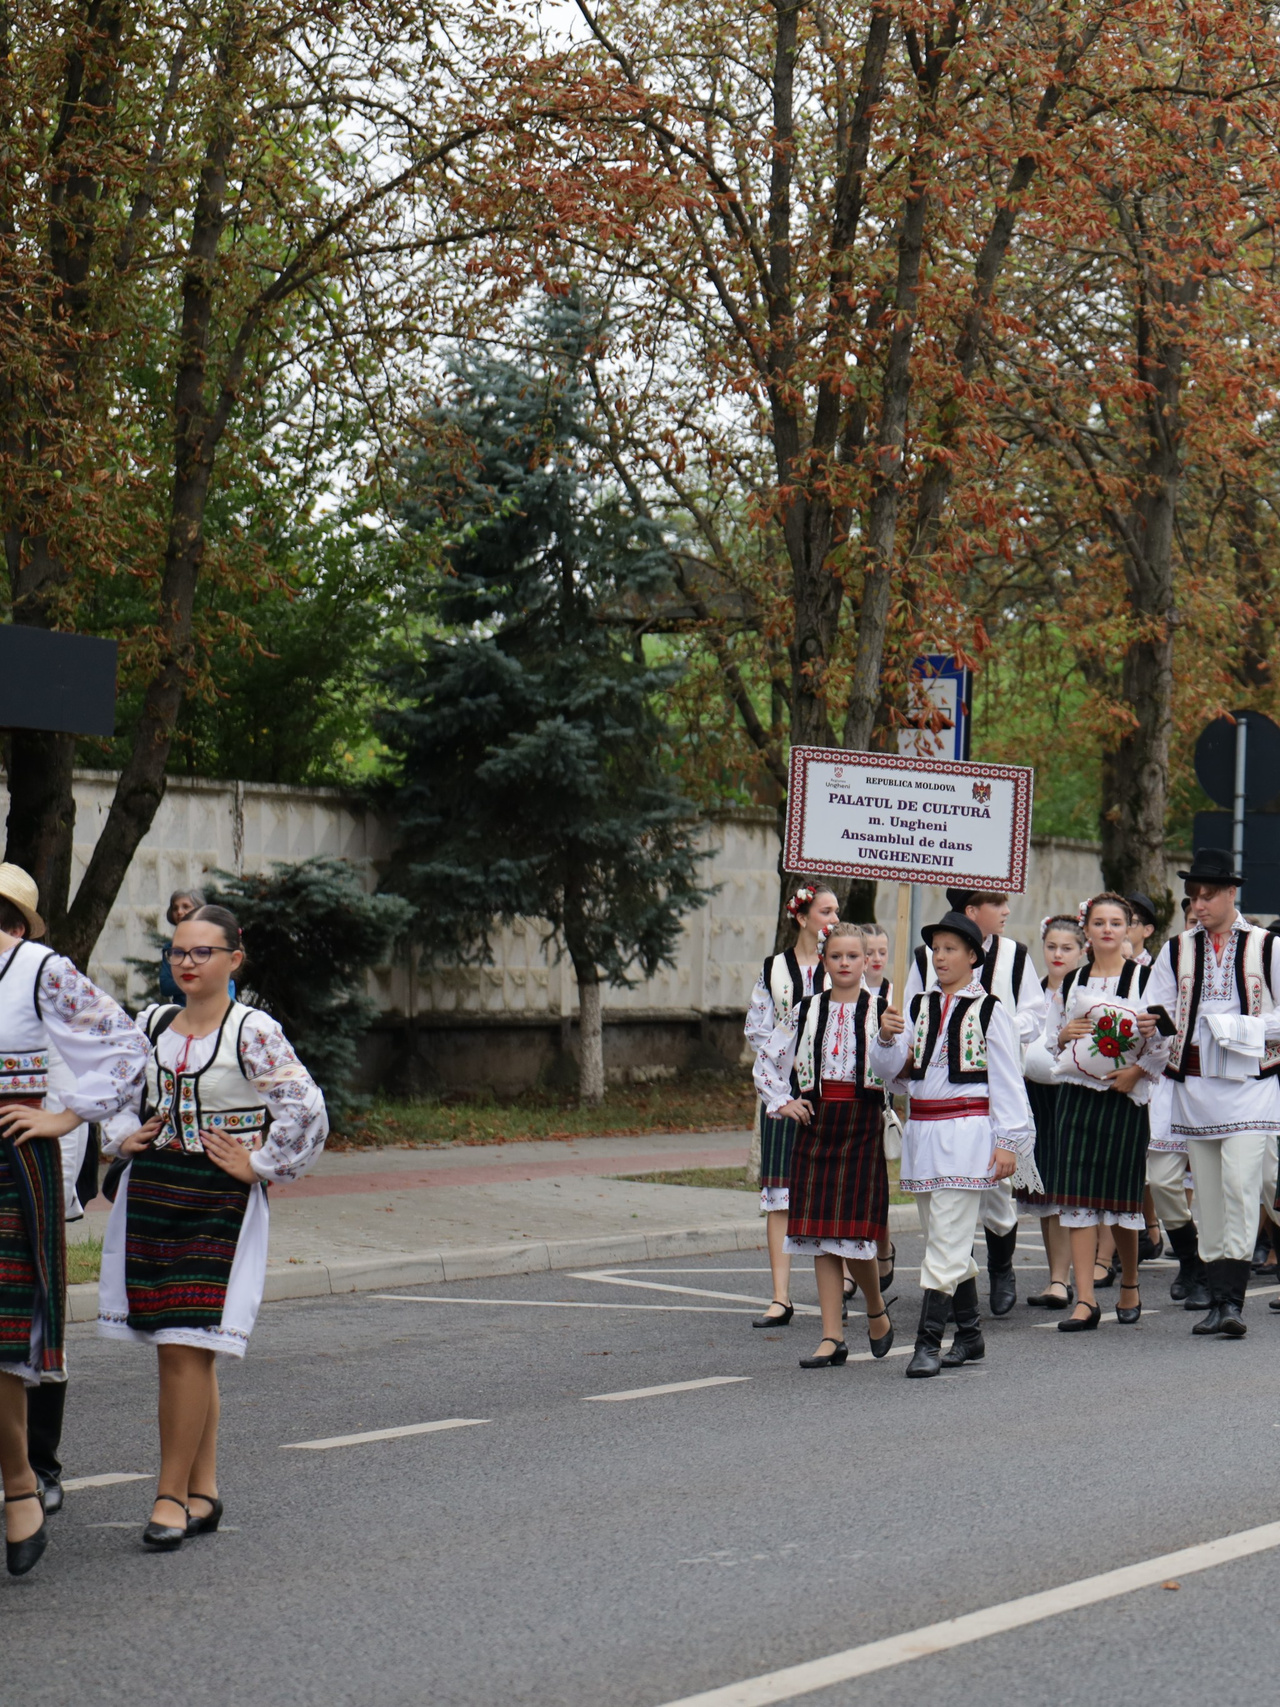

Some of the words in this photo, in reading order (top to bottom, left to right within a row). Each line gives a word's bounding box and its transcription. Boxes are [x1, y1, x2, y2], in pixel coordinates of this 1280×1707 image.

[825, 781, 851, 789] Ungheni
[865, 776, 913, 788] REPUBLICA
[914, 781, 956, 792] MOLDOVA
[828, 792, 893, 810] PALATUL
[897, 799, 919, 812] DE
[922, 802, 992, 819] CULTURĂ
[868, 816, 885, 826] m.
[890, 816, 948, 832] Ungheni
[840, 828, 915, 846] Ansamblul
[919, 836, 935, 848] de
[939, 838, 973, 851] dans
[858, 847, 955, 867] UNGHENENII
